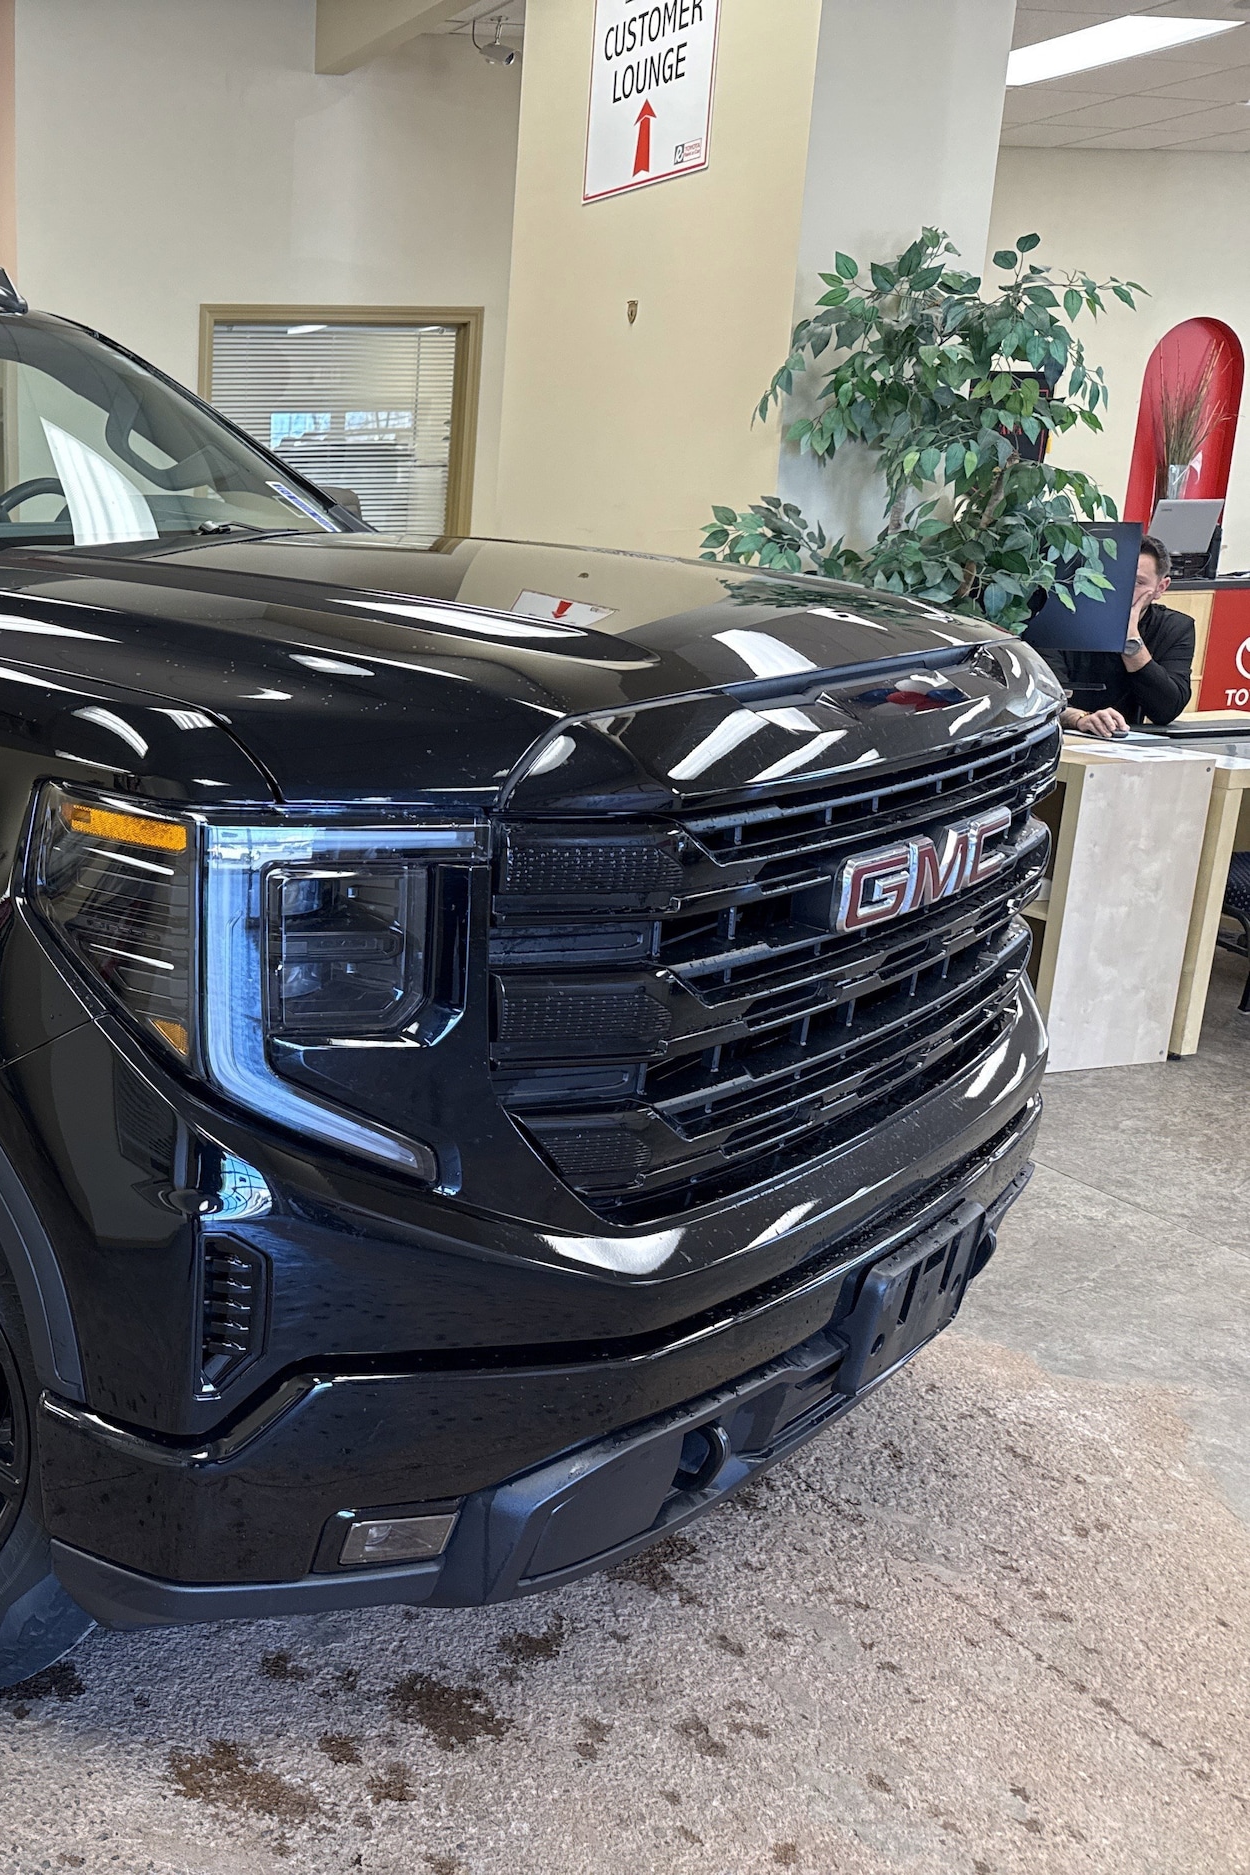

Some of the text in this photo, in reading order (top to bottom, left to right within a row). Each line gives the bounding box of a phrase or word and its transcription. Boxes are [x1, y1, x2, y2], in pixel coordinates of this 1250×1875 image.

[604, 0, 703, 61] CUSTOMER
[612, 41, 688, 104] LOUNGE
[1224, 688, 1250, 707] TO
[837, 807, 1012, 933] GMC
